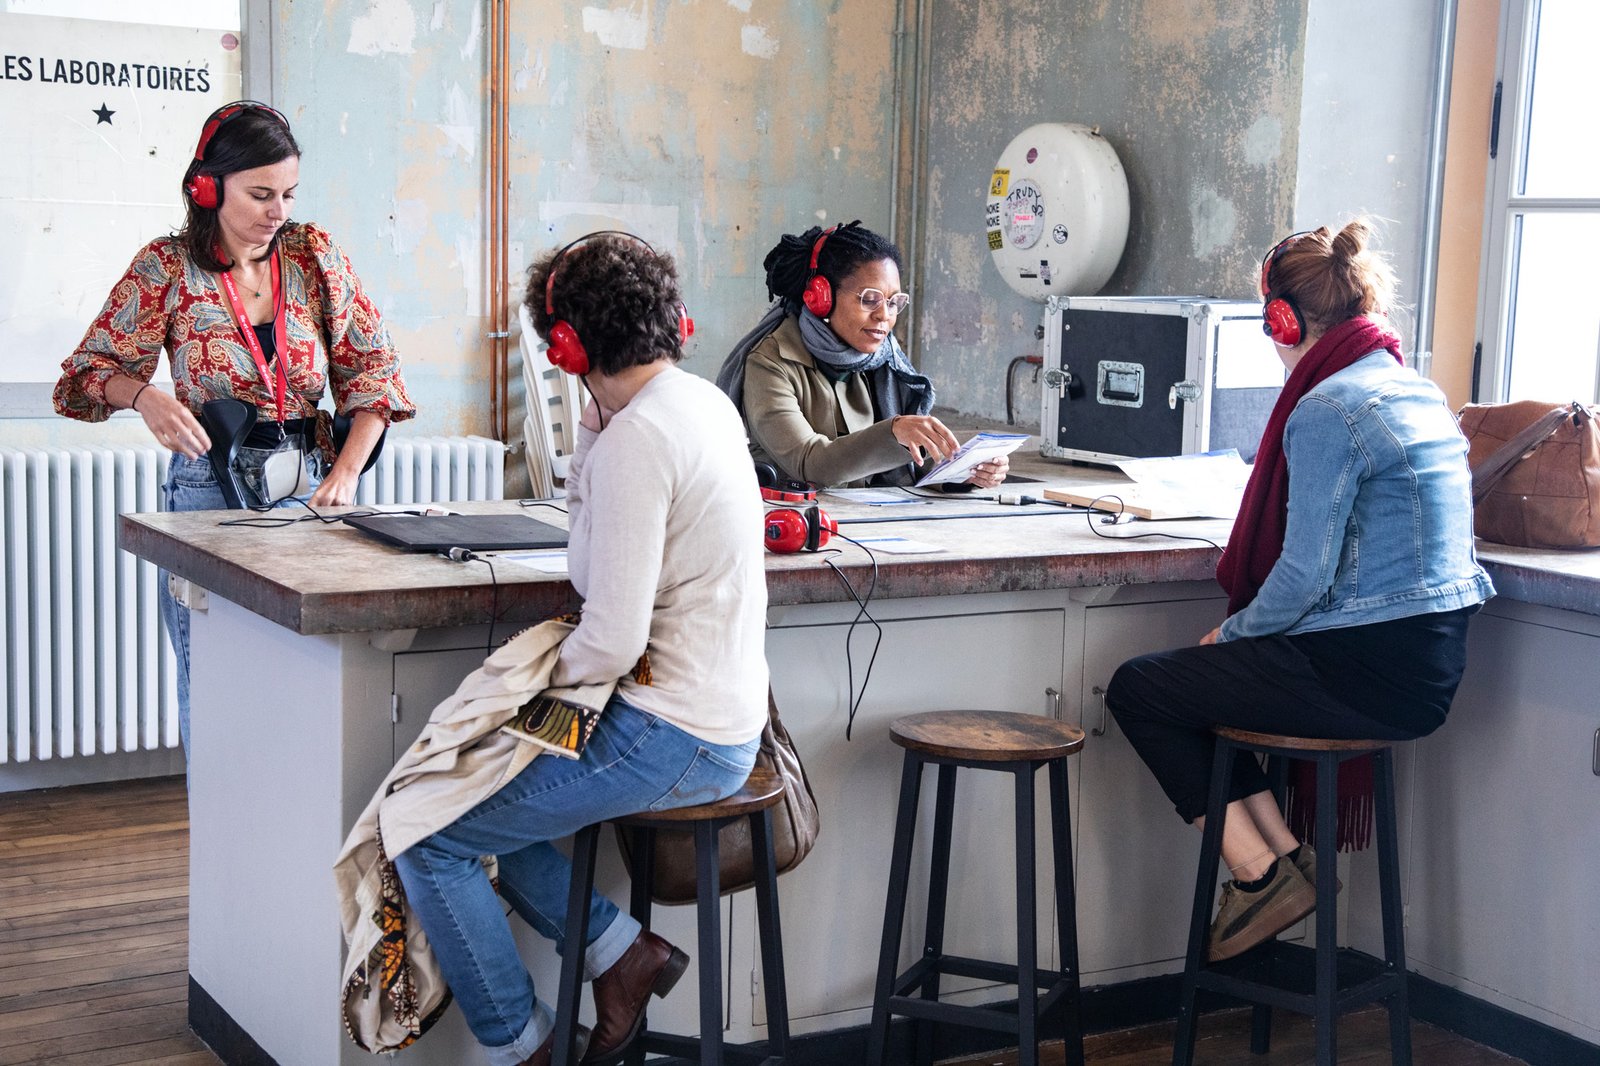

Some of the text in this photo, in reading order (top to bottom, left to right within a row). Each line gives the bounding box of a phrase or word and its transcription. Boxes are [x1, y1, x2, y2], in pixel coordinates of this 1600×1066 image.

[0, 55, 211, 93] ES LABORATOIRES
[1006, 186, 1042, 208] TRUDY
